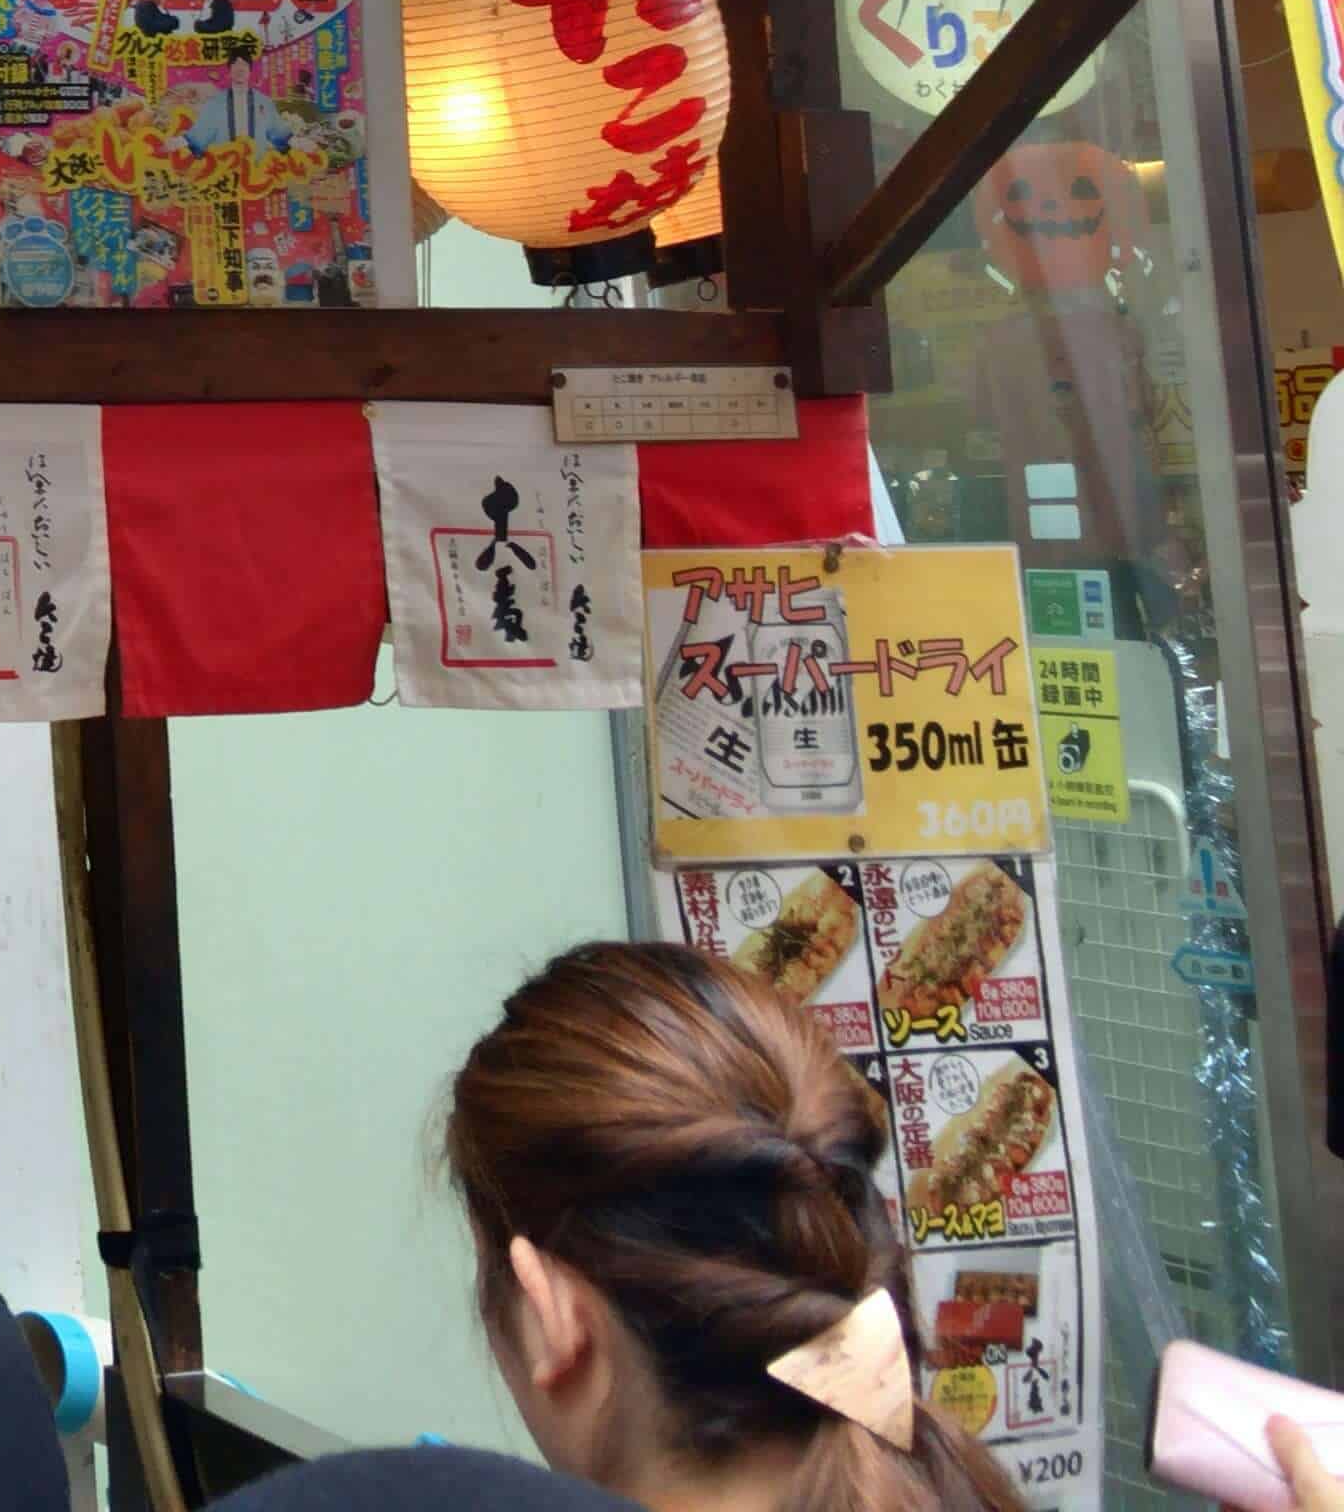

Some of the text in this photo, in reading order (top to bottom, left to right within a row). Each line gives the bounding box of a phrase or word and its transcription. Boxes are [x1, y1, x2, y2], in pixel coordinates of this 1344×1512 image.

[672, 565, 826, 625] アサヒ
[678, 636, 1019, 701] スーパードライ
[1039, 660, 1101, 683] 24時間
[867, 718, 1030, 771] 350ml 缶
[883, 1004, 967, 1046] ソース
[969, 1024, 1013, 1041] Sauce
[1018, 1450, 1083, 1484] ¥200
